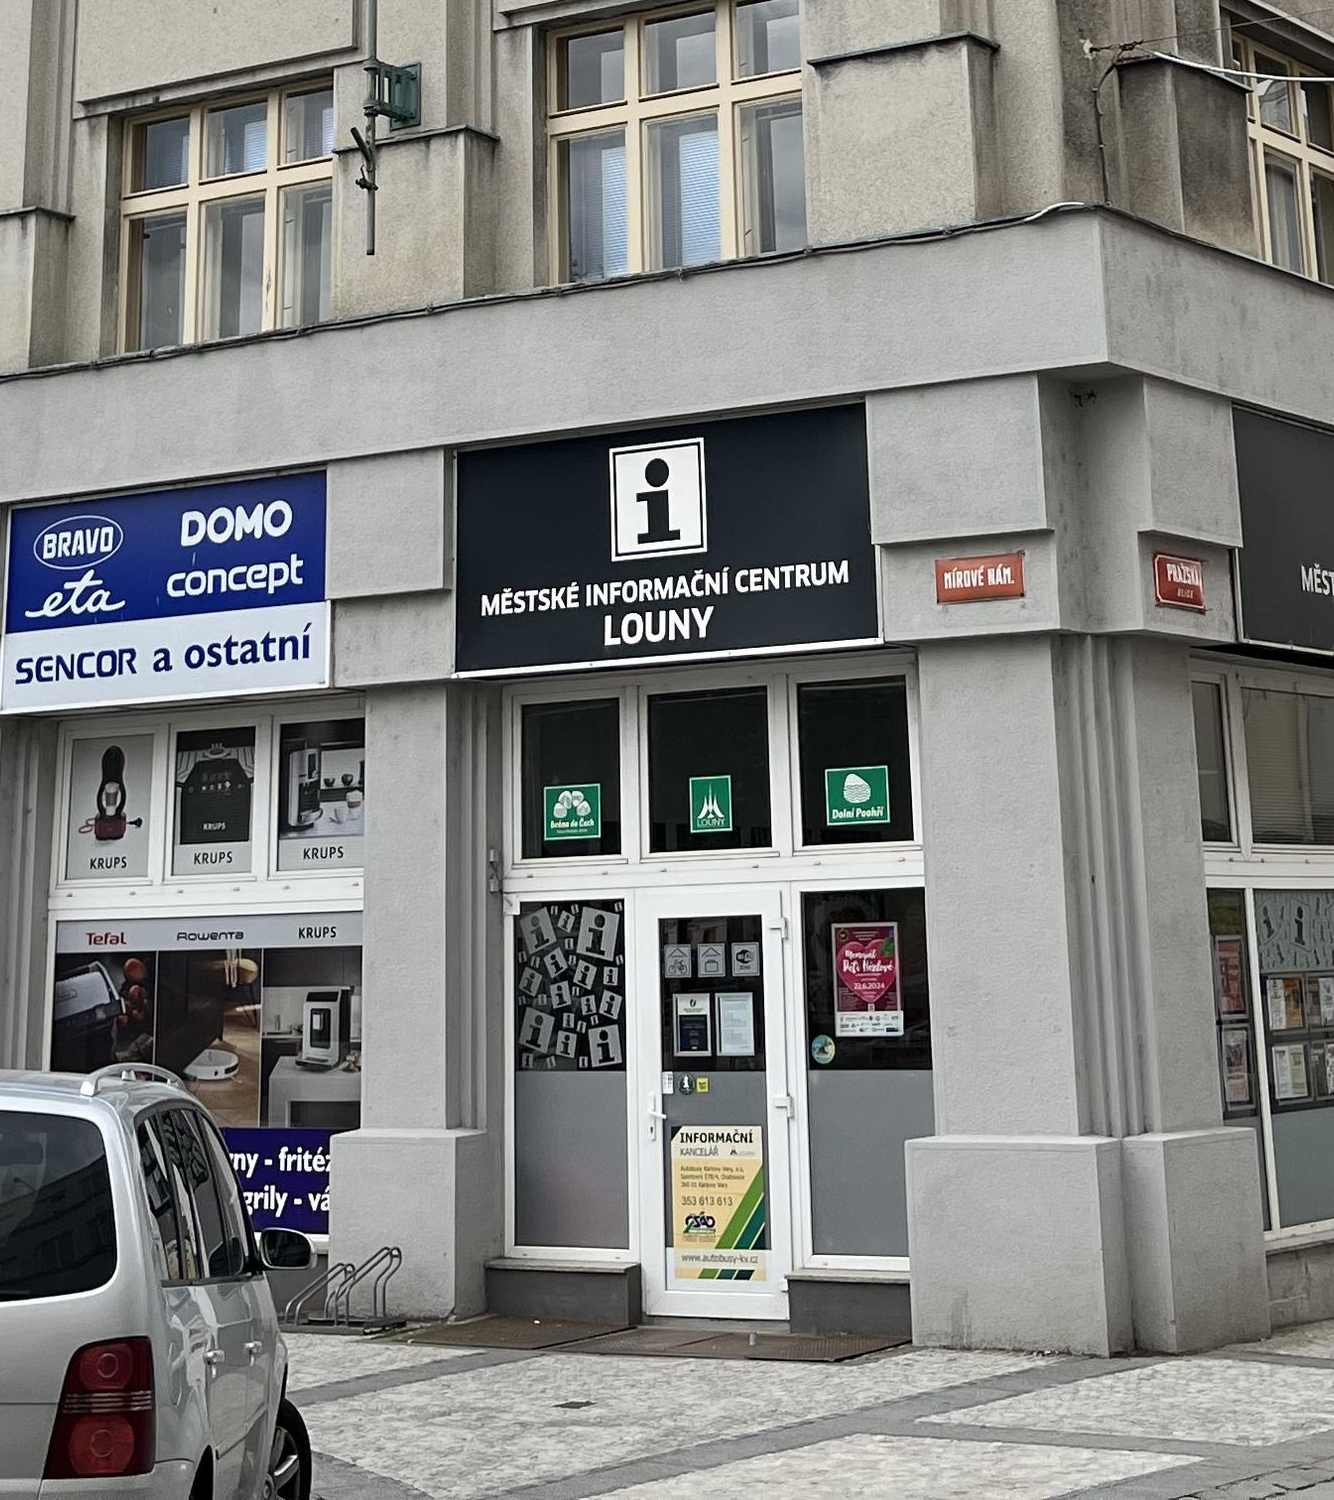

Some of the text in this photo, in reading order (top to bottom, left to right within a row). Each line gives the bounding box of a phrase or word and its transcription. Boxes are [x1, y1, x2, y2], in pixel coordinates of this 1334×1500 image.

[180, 500, 292, 546] DOMO
[42, 526, 114, 559] BRAVO
[167, 553, 303, 598] concept
[944, 563, 1015, 589] MÍROVÉ NÁM.
[1167, 563, 1199, 586] PRAŽSKÁ
[25, 569, 125, 618] eta
[481, 560, 849, 617] MĚSTSKÉ INFORMAČNÍ CENTRUM
[604, 606, 714, 646] LOUNY
[15, 622, 312, 685] SENCOR a ostatní
[697, 818, 725, 827] LOUNY
[832, 806, 884, 820] Dolní Poohří
[89, 856, 127, 870] KRUPS
[193, 852, 233, 865] KRUPS
[303, 846, 344, 860] KRUPS
[86, 932, 127, 946] Tefal
[298, 926, 337, 939] KRUPS
[680, 1129, 753, 1143] INFORMAČNÍ
[680, 1145, 719, 1156] KANCELÁŘ
[681, 1196, 733, 1206] 353 613 613
[681, 1254, 759, 1264] www.autobusy-kv.cz
